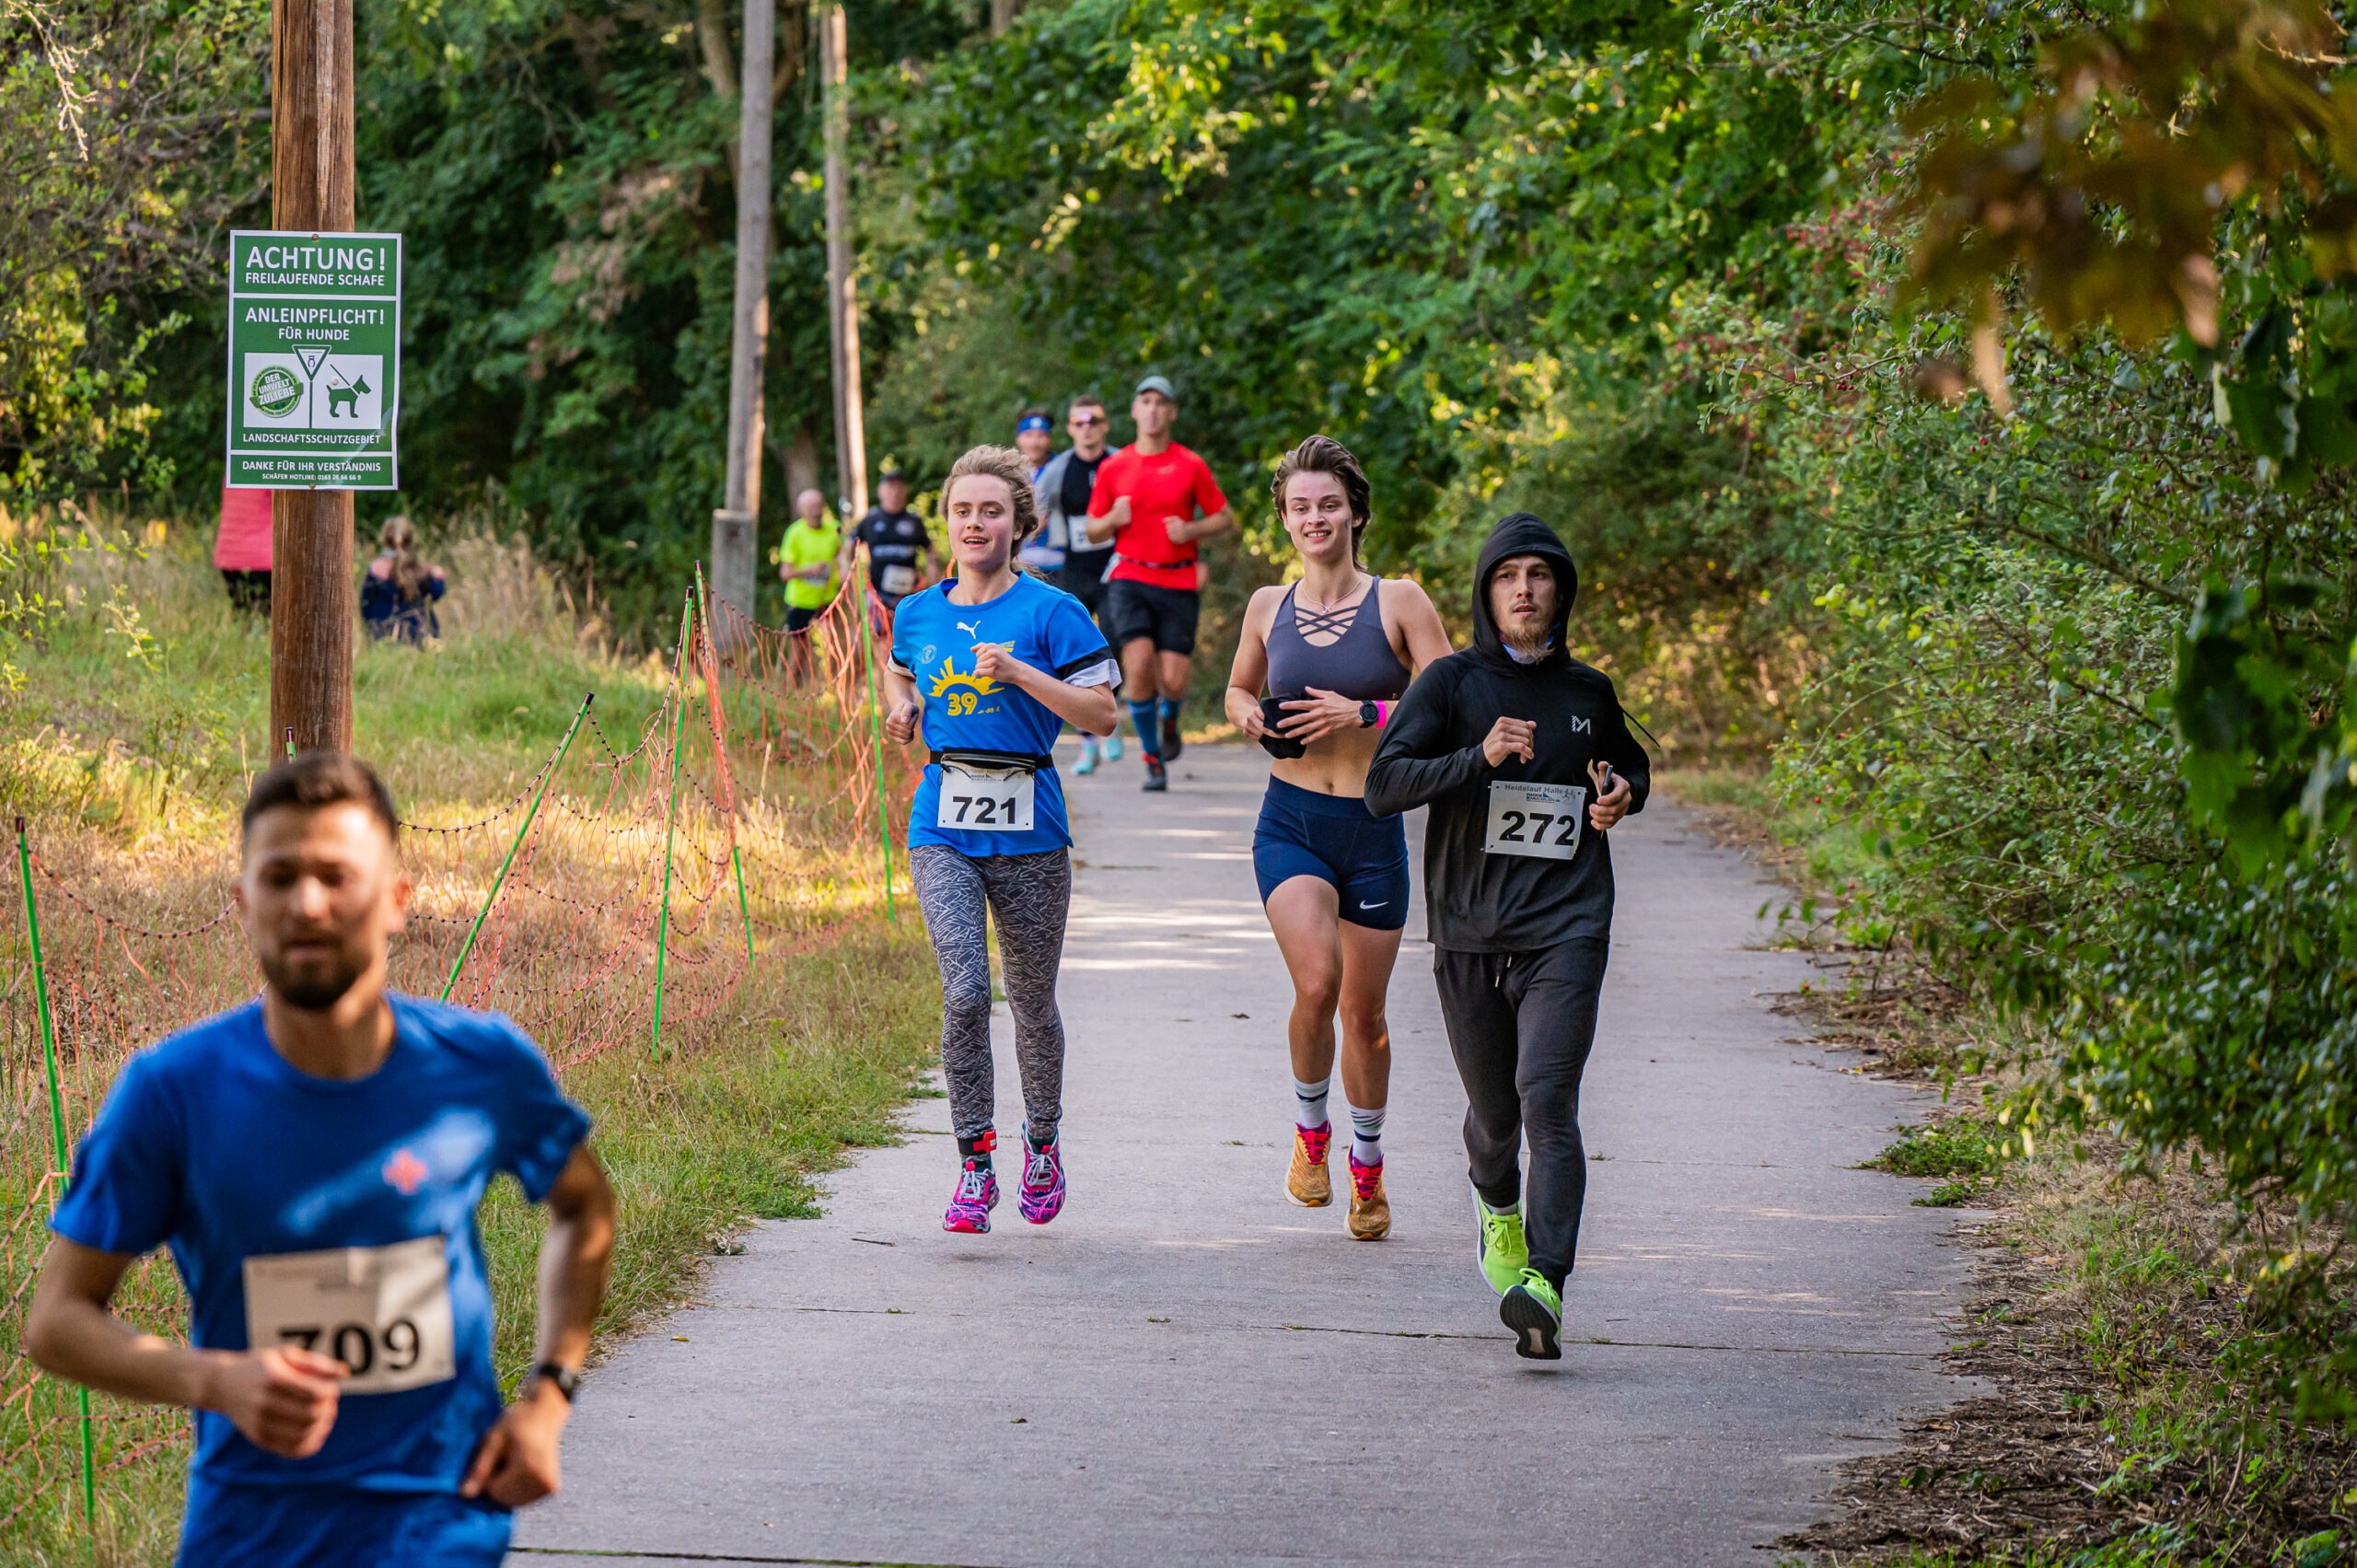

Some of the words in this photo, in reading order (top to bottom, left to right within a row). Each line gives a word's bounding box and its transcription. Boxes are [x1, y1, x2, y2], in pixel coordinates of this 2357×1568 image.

[245, 273, 334, 285] FREILAUFENDE
[338, 274, 385, 285] SCHAFE
[245, 308, 384, 324] ANLEINPFLICHT!
[278, 326, 302, 340] FÜR
[306, 329, 350, 341] HUNDE
[259, 378, 290, 394] UMWELT
[264, 373, 281, 384] DER
[259, 386, 296, 405] ZULIEBE
[242, 434, 380, 445] LANDSCHAFTSSCHUTZGEBIET
[242, 460, 274, 470] DANKE
[277, 460, 296, 471] FÜR
[298, 462, 314, 471] IHR
[317, 460, 381, 471] VERSTÄNDNIS
[946, 692, 978, 716] 39
[1504, 784, 1541, 793] Heidelauf
[952, 796, 1016, 825] 721
[1499, 810, 1576, 847] 272
